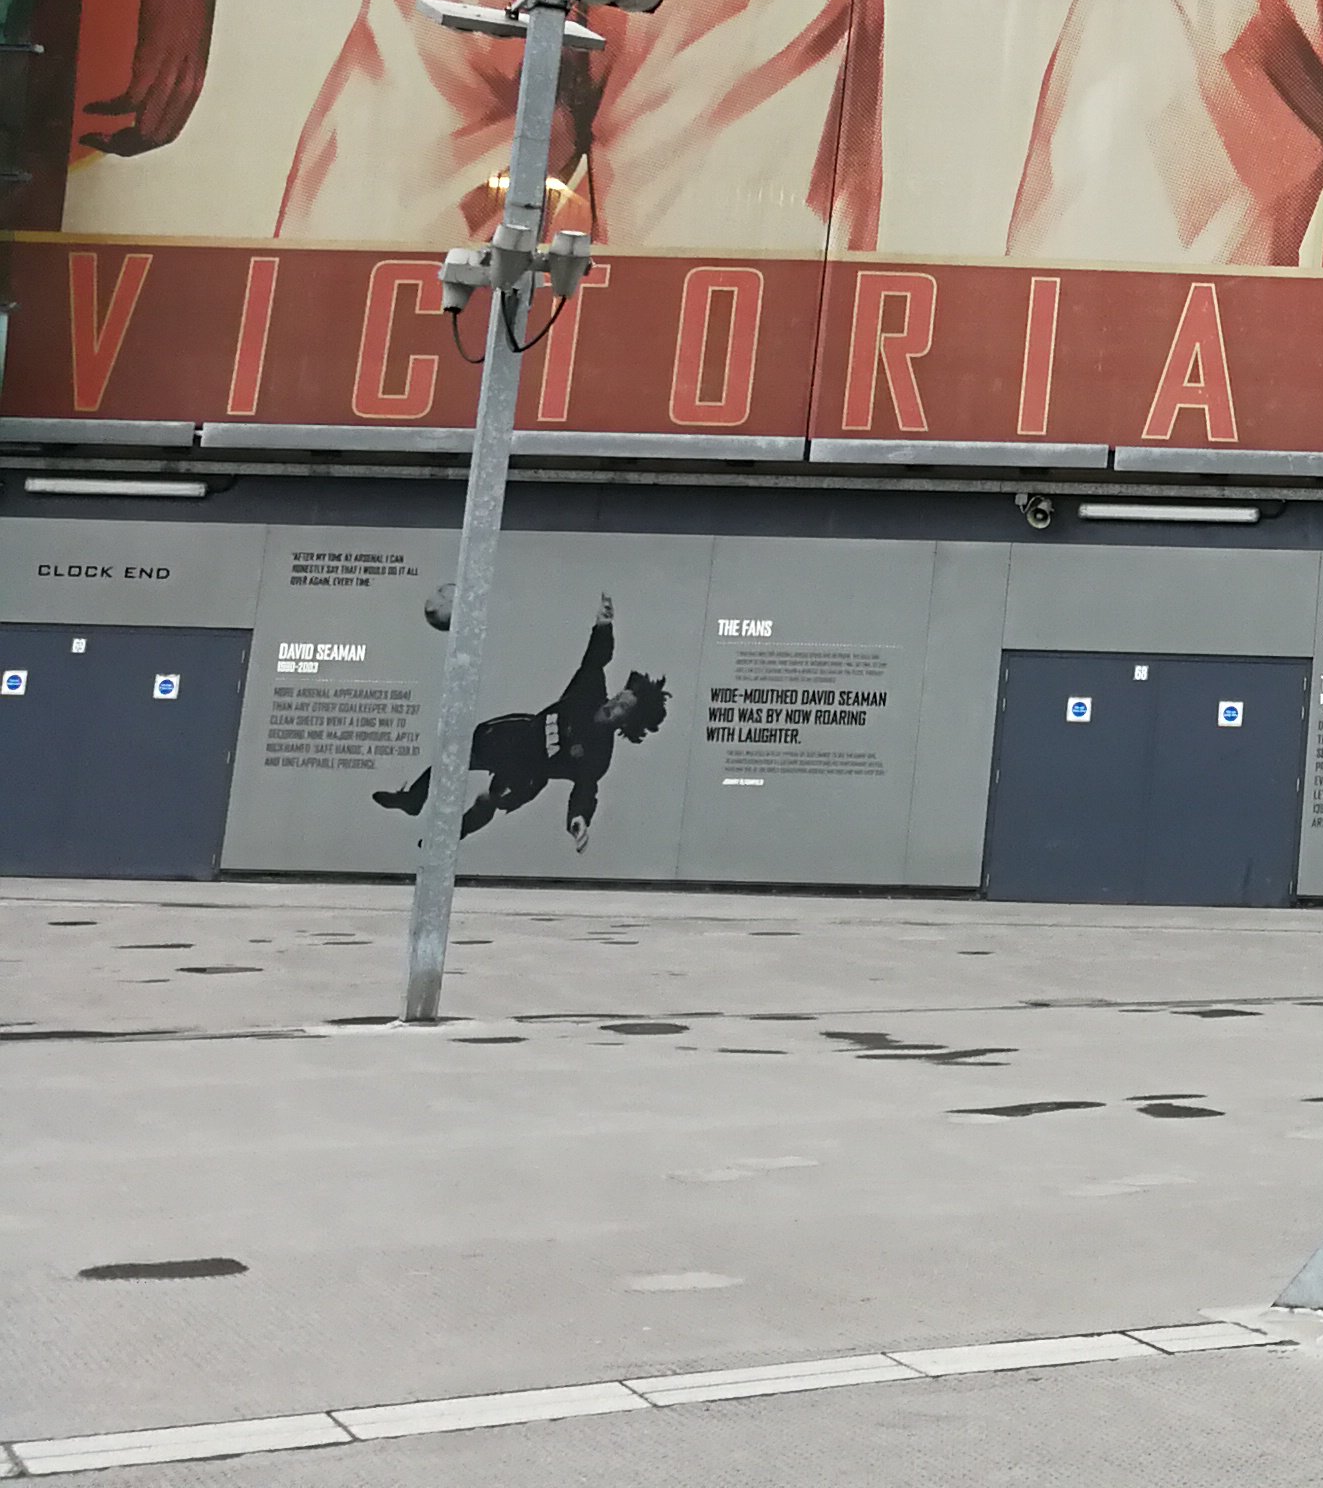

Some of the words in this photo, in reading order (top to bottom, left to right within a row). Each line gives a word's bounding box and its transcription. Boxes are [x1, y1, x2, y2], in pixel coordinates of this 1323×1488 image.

[68, 252, 1238, 444] VICTORIA
[38, 564, 112, 578] CLOCK
[124, 567, 170, 579] END
[718, 619, 738, 636] THE
[741, 620, 773, 636] FANS
[278, 643, 314, 660] DAVID
[316, 644, 366, 661] SEAMAN
[1134, 665, 1149, 680] 68
[711, 688, 798, 704] WIDE-MOUTHED
[801, 690, 835, 705] DAVID
[838, 691, 887, 706] SEAMAN
[709, 708, 734, 723] WHO
[738, 708, 762, 723] WAS
[766, 709, 780, 724] BY
[785, 709, 810, 724] NOW
[814, 710, 866, 725] ROARING
[707, 727, 735, 742] WITH
[738, 728, 801, 744] LAUGHTER.
